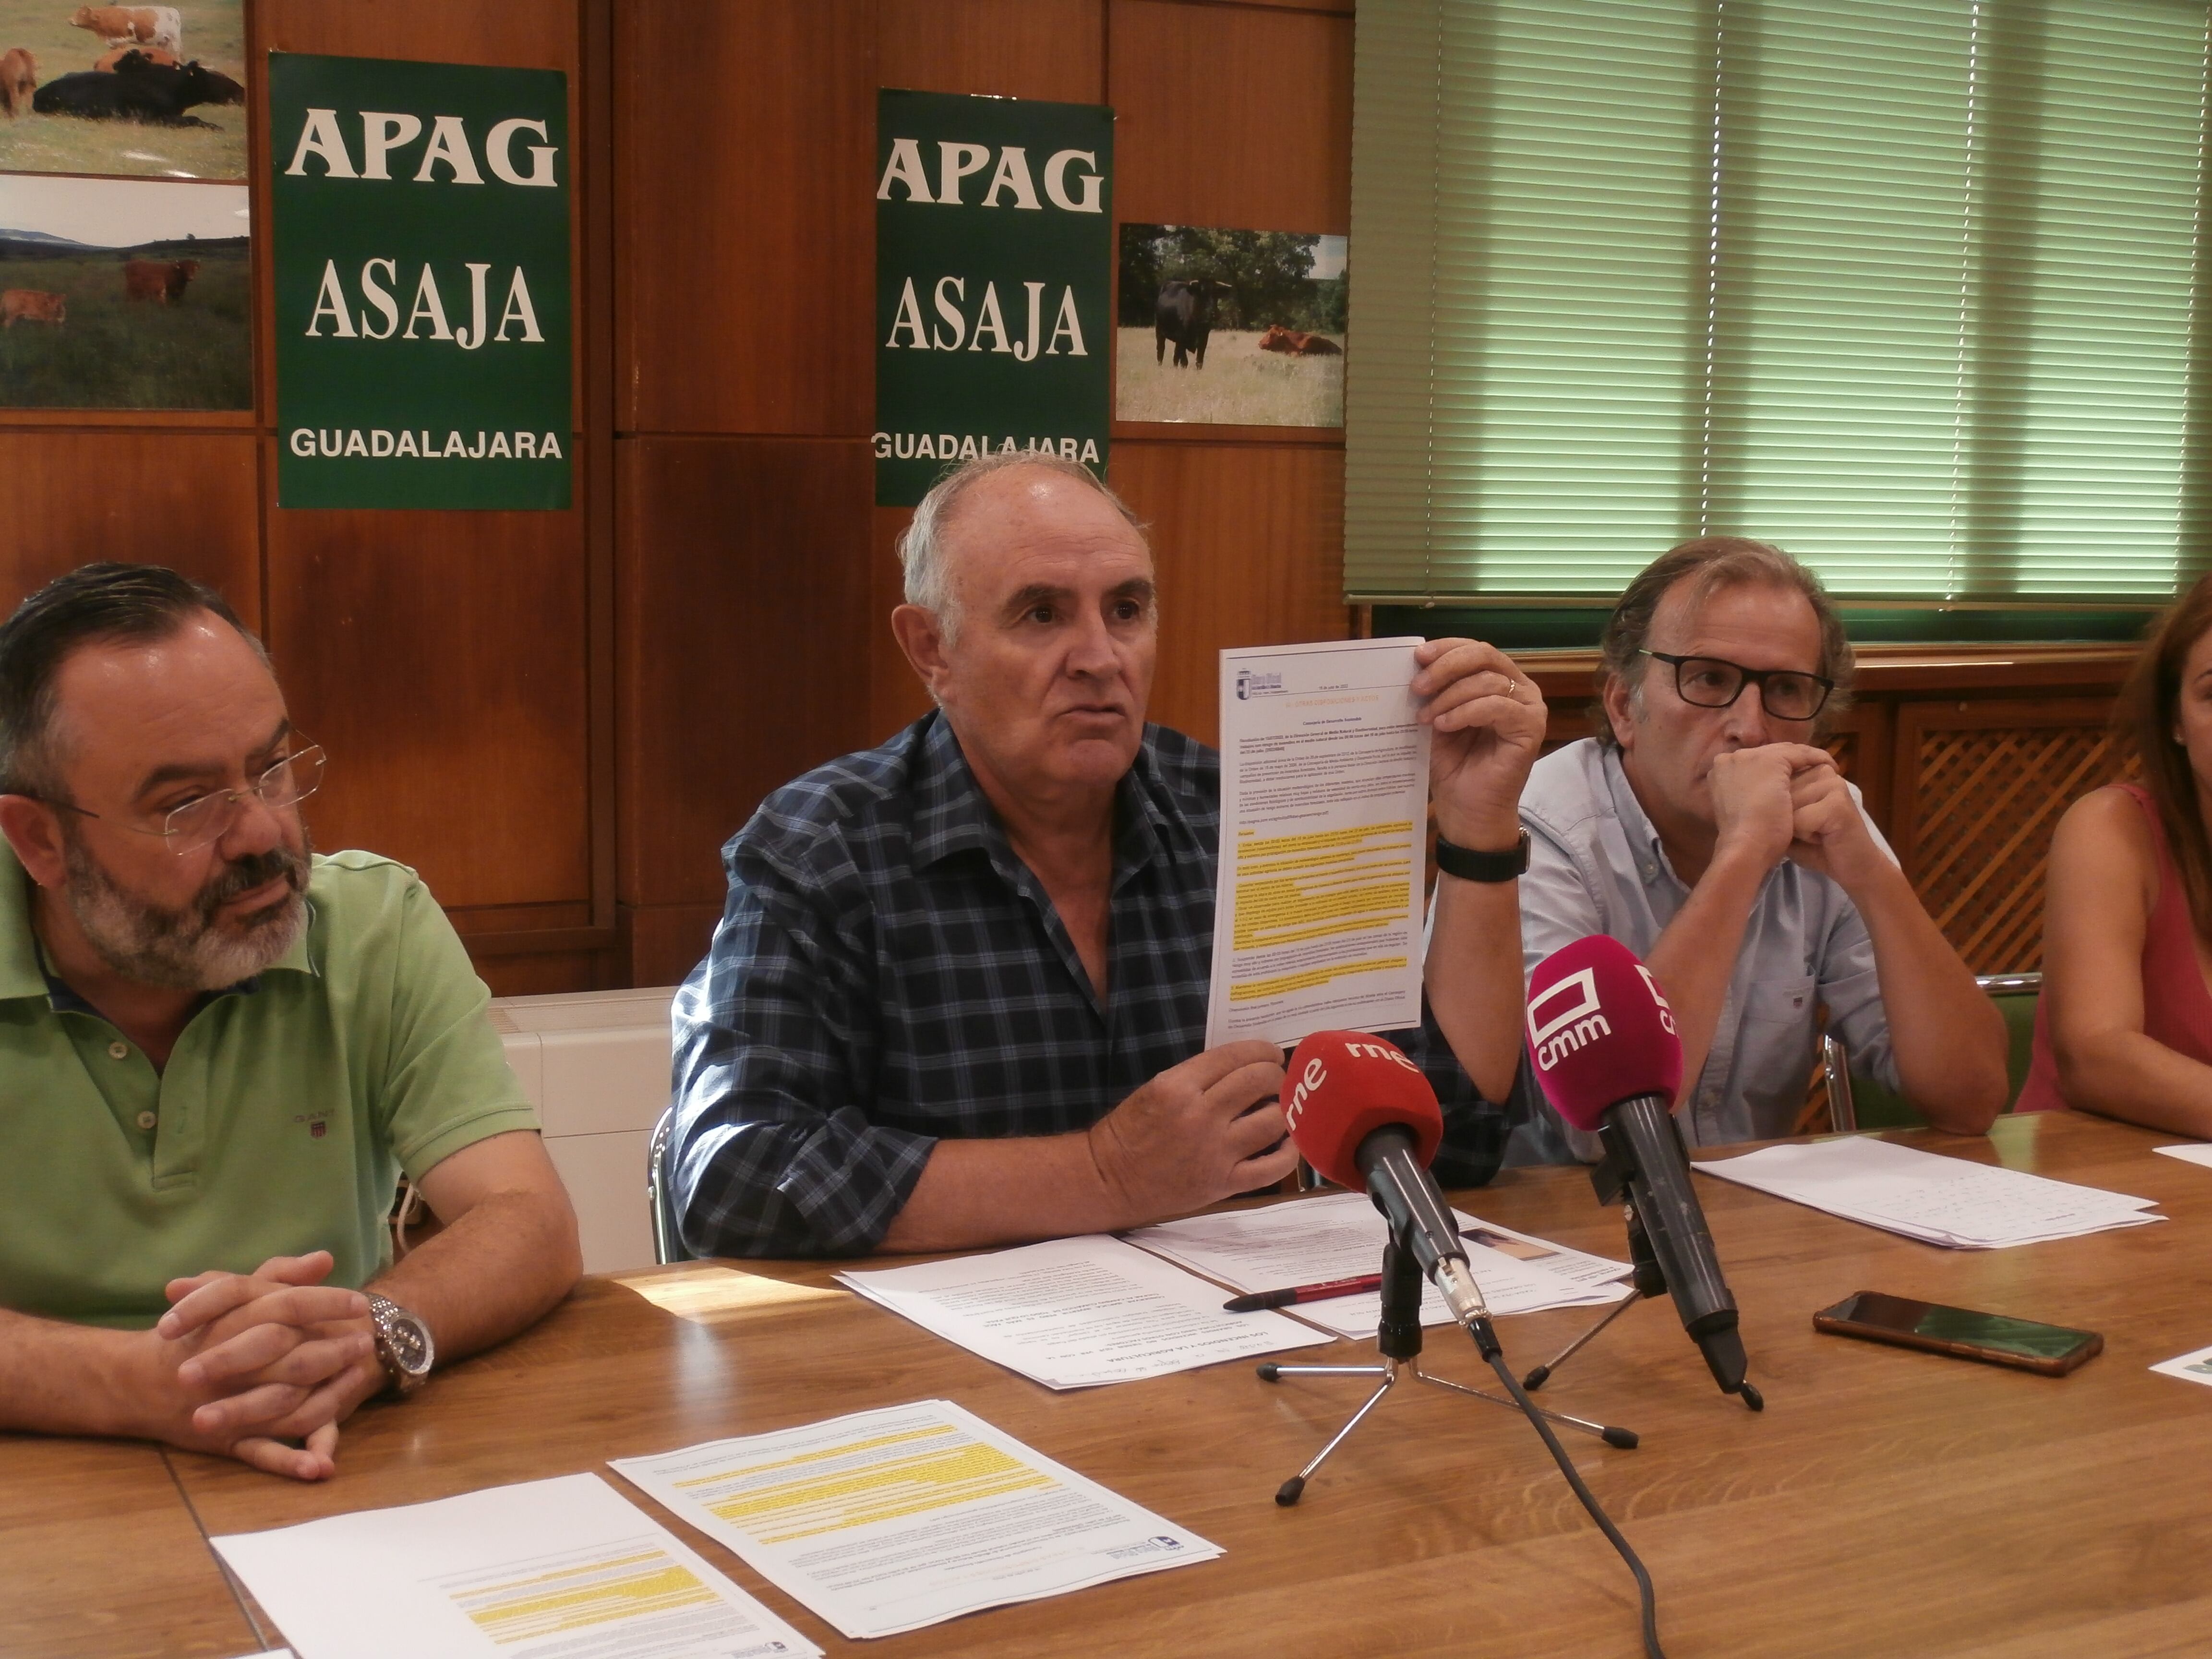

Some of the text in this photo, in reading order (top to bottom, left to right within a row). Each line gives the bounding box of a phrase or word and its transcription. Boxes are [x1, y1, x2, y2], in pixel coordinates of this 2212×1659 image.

[285, 108, 559, 187] APAG
[877, 138, 1104, 214] APAG
[305, 258, 545, 350] ASAJA
[885, 276, 1088, 362] ASAJA
[289, 428, 563, 459] GUADALAJARA
[1346, 1043, 1419, 1073] rne
[1538, 1014, 1611, 1071] cmm
[1286, 1058, 1327, 1131] rne
[1106, 1348, 1174, 1362] AGRICULTURA
[1197, 1334, 1250, 1346] INCENDIOS
